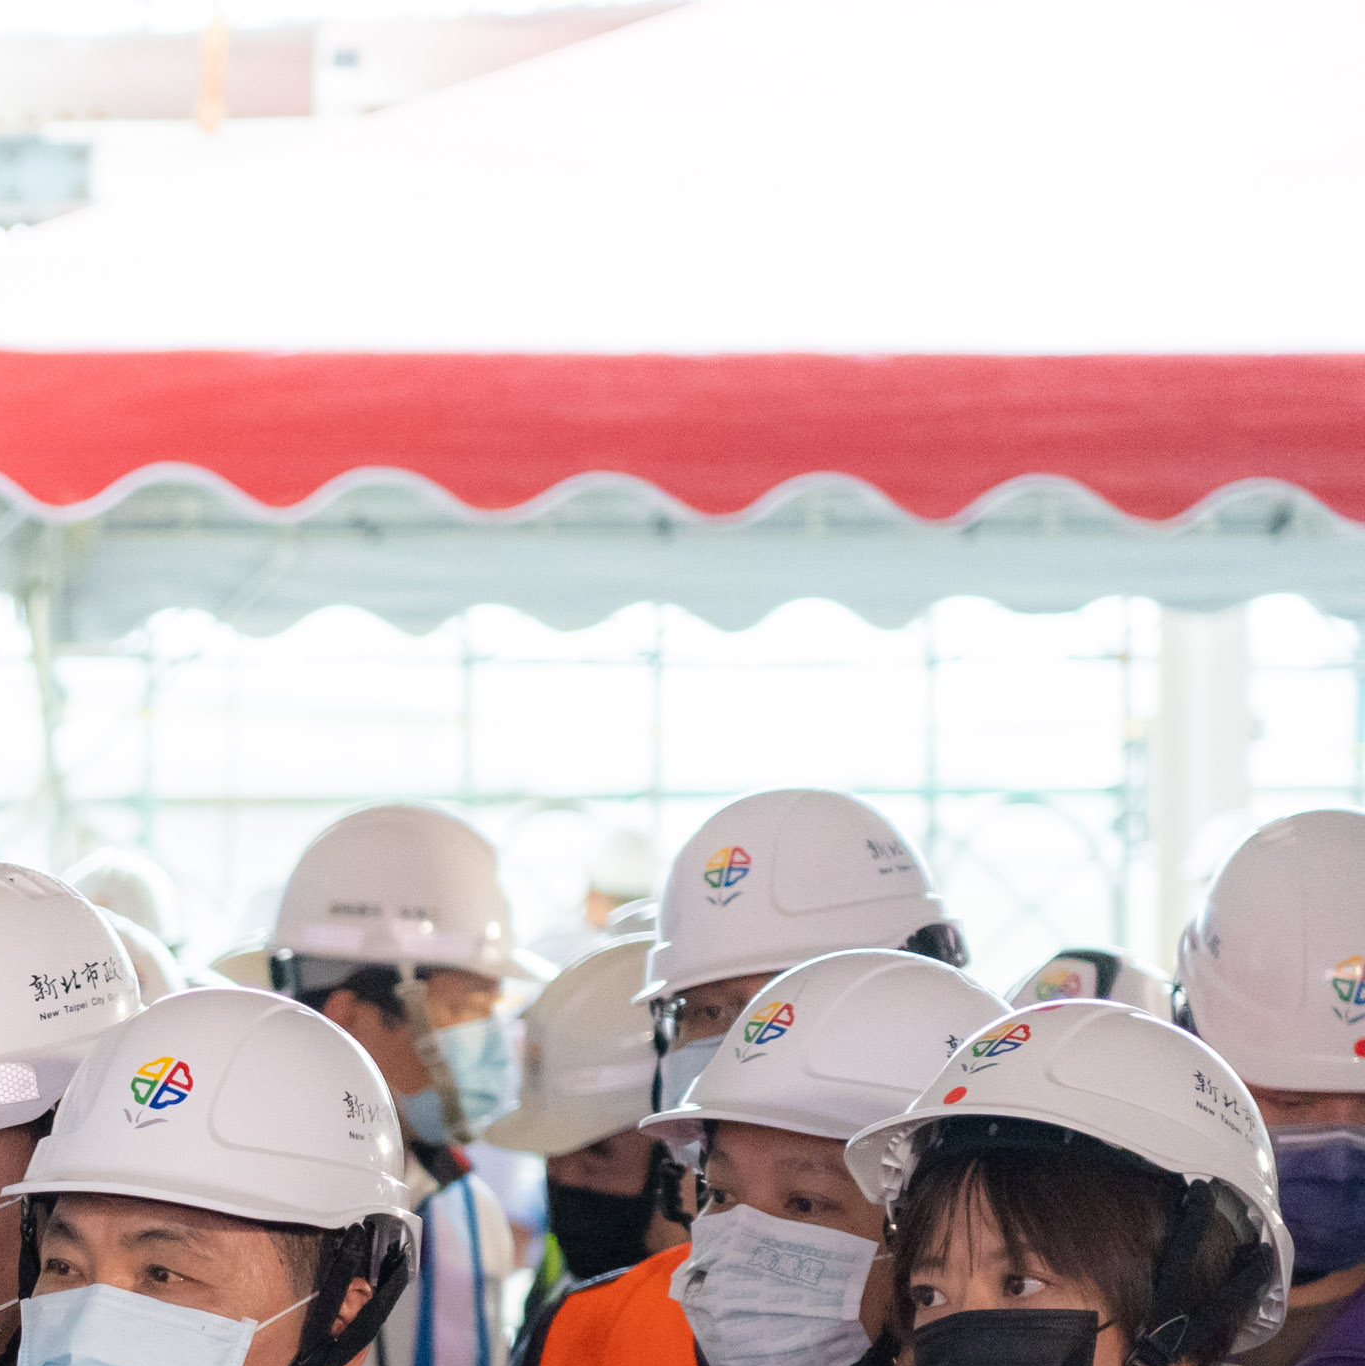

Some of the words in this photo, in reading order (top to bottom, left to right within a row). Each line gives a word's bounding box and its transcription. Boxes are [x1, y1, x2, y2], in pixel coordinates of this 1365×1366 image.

[39, 1009, 60, 1021] New
[63, 1001, 88, 1014] Taipei
[92, 996, 105, 1006] City
[1196, 1101, 1215, 1115] New
